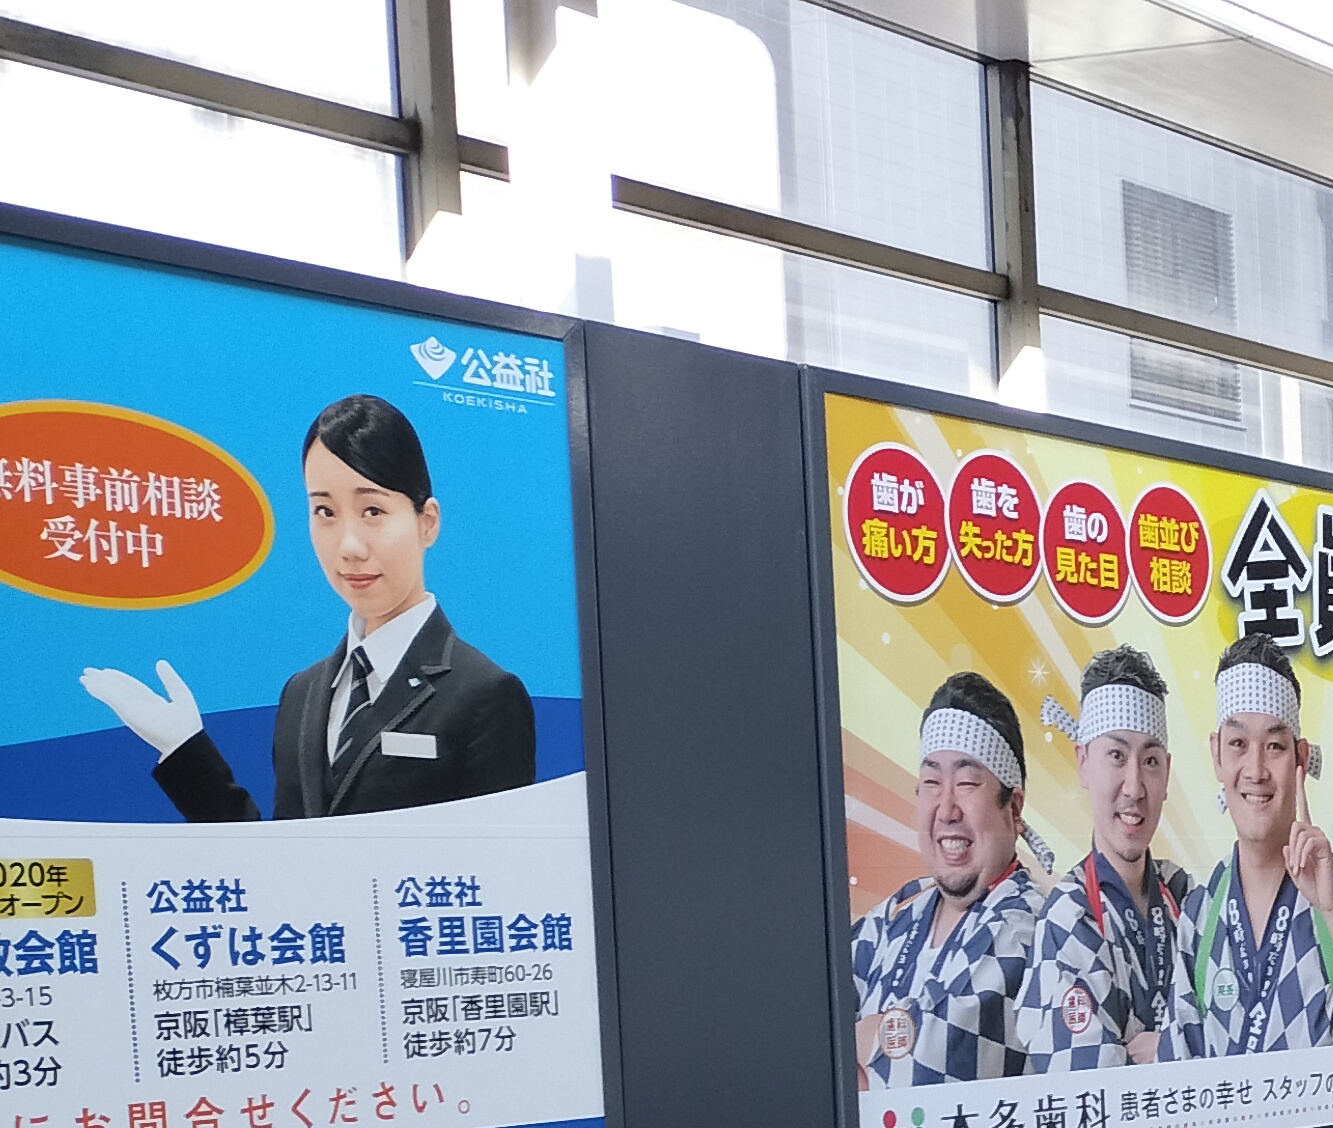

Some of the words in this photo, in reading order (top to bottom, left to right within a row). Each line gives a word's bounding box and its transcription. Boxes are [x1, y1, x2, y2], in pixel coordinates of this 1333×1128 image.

[460, 346, 557, 398] 公益社
[442, 391, 529, 415] KOEKISHA
[871, 472, 926, 515] 歯が
[970, 477, 1020, 521] 歯を
[40, 514, 164, 569] 受付中
[861, 517, 938, 566] 痛い方
[959, 520, 1036, 568] 失った方
[1062, 504, 1109, 544] 歯の
[1137, 513, 1200, 554] 歯並び
[1055, 546, 1121, 590] 見た目
[1149, 556, 1193, 596] 相談
[0, 890, 84, 917] オープン
[146, 878, 248, 914] 公益社
[395, 875, 483, 909] 公益社
[151, 922, 346, 970] くずは会館
[397, 912, 573, 958] 香里園会館
[153, 971, 358, 1002] 枚方市楠葉並木2-13-11
[400, 963, 554, 990] 寝屋川市寿町60-26
[153, 1003, 314, 1041] 京阪「樟葉駅」
[400, 989, 560, 1025] 京阪「香里園駅」
[1, 1018, 60, 1048] バス
[402, 1025, 518, 1059] 徒歩約7分
[157, 1040, 289, 1078] 徒歩約5分
[1119, 1079, 1254, 1123] 患者さまの幸せ
